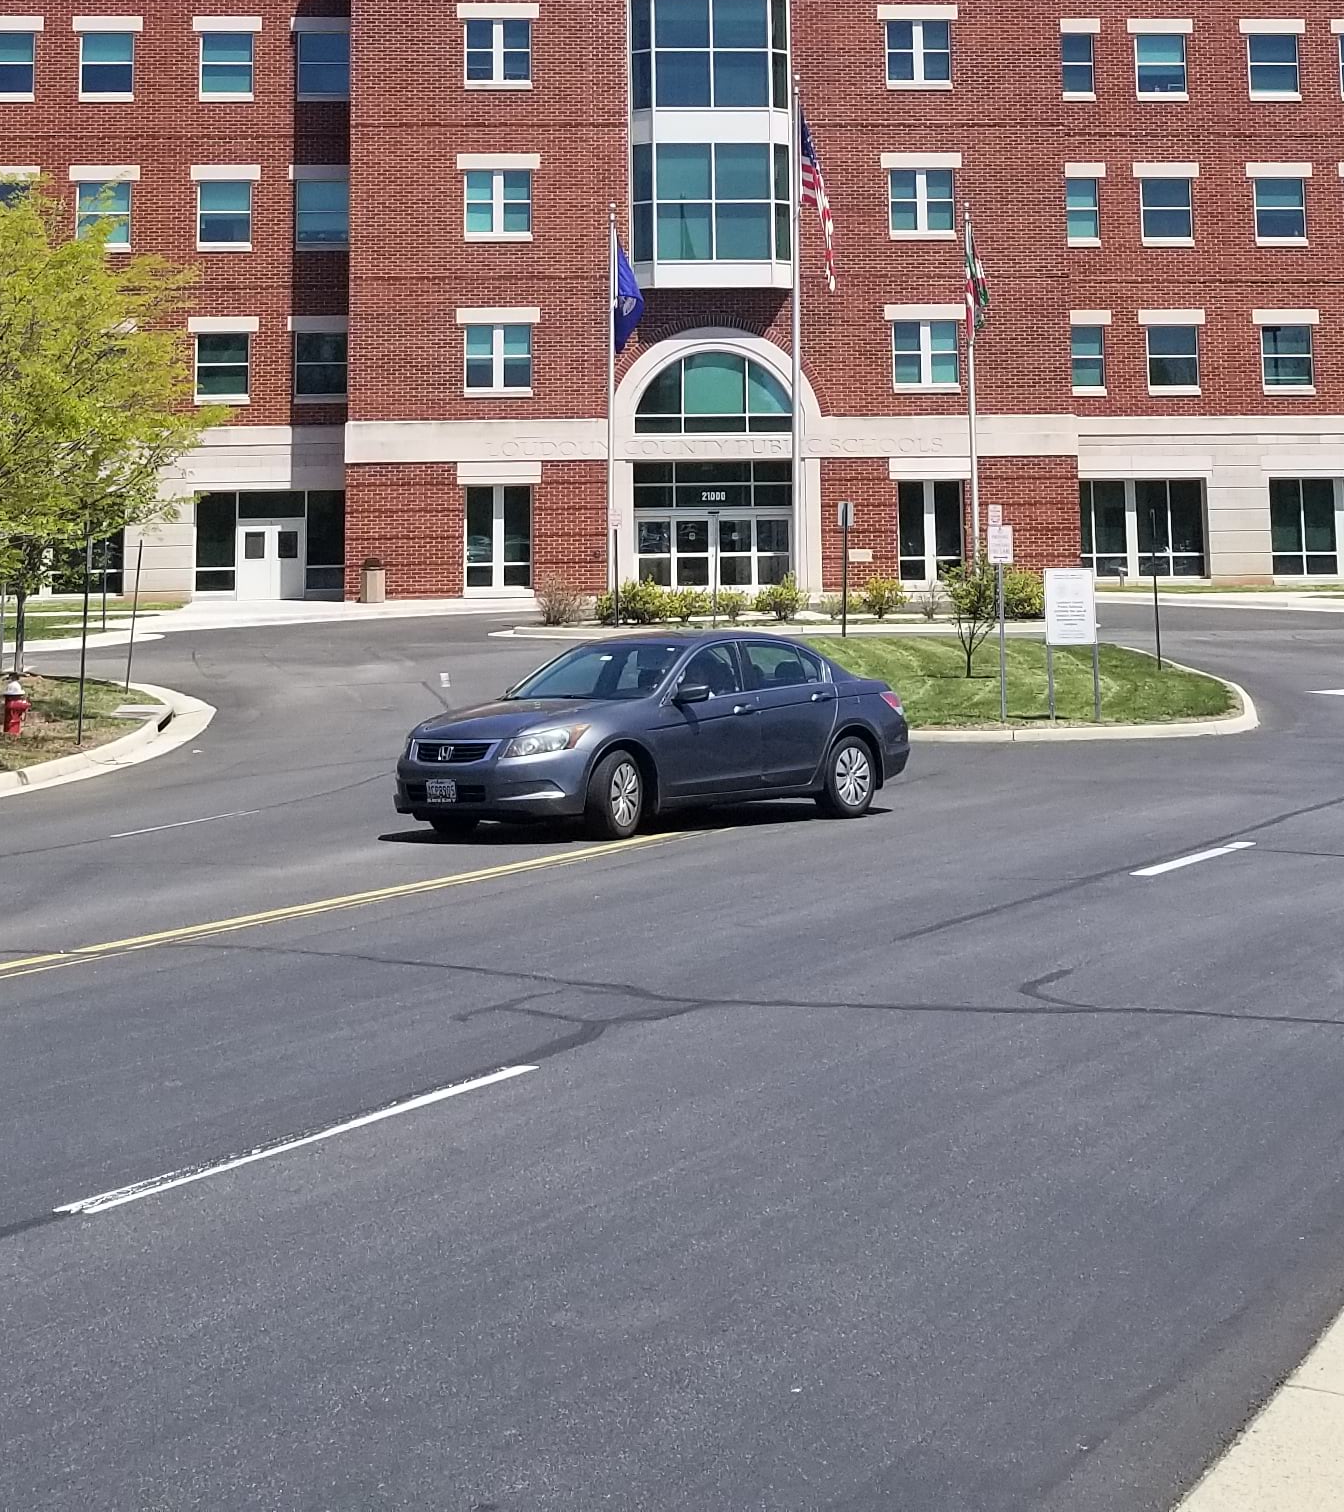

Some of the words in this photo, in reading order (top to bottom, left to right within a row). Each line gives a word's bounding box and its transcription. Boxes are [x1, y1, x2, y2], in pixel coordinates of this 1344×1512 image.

[624, 440, 727, 455] COUNTY
[829, 437, 944, 453] SCHOOLS
[701, 491, 726, 501] 21000
